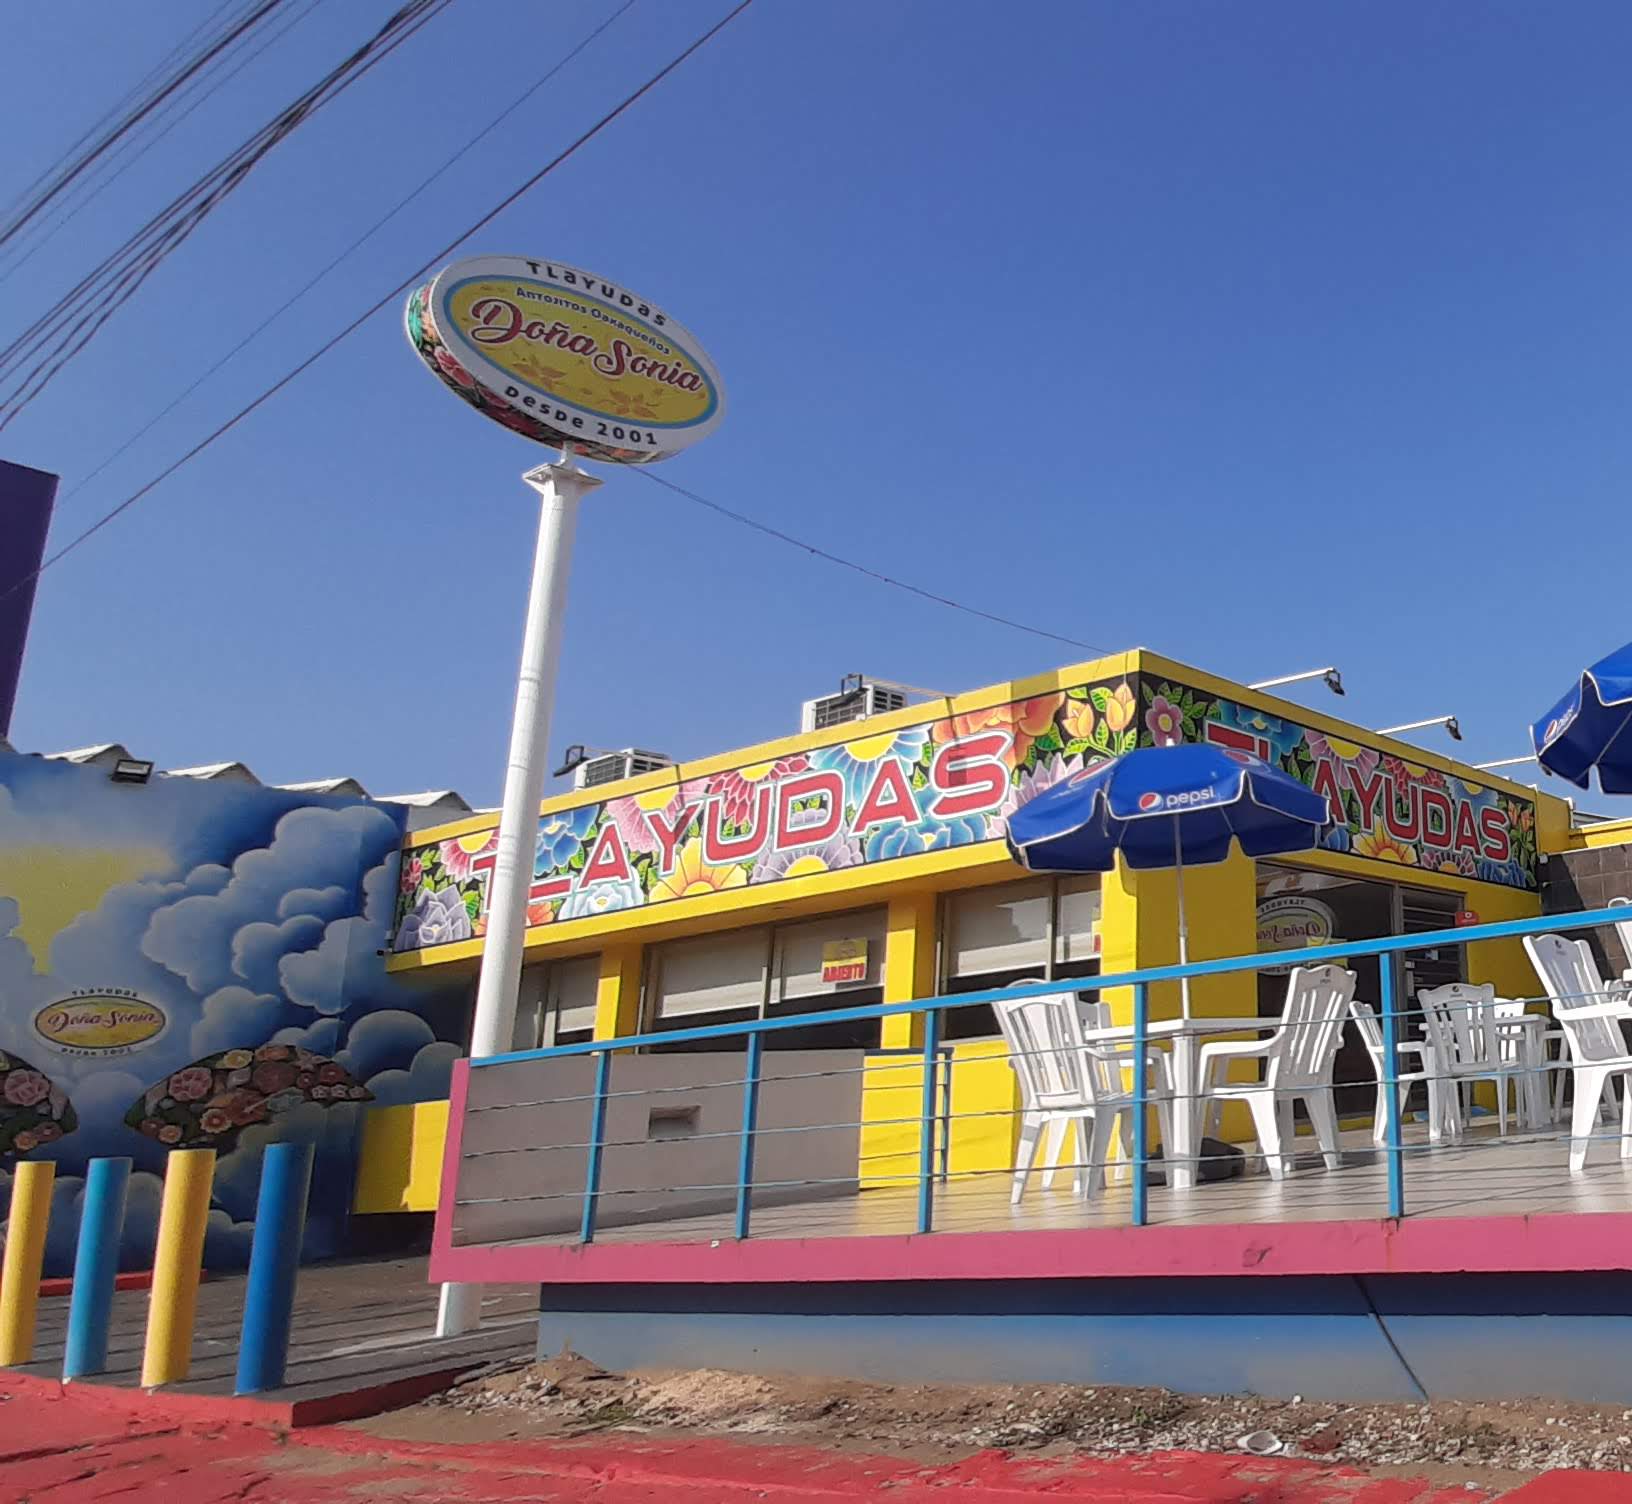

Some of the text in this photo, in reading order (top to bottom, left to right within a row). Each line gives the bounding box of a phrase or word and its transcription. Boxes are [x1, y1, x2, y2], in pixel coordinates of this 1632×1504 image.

[471, 298, 703, 391] Doña Sonia
[597, 422, 657, 445] 2001
[1166, 785, 1216, 808] pepsi
[48, 1010, 101, 1033] Doña
